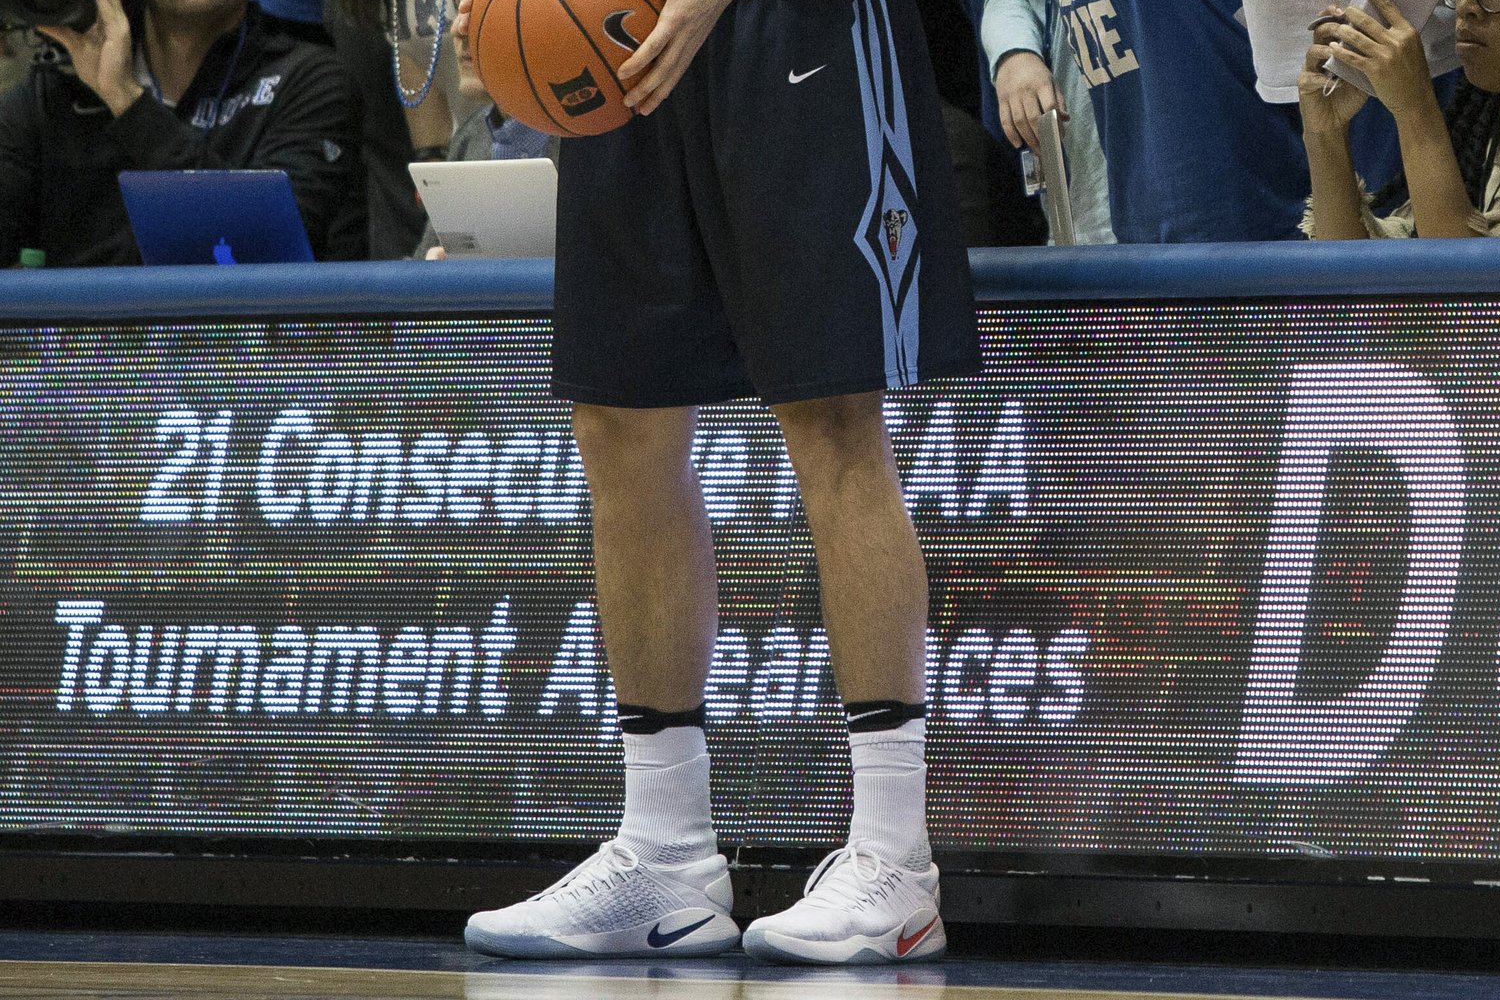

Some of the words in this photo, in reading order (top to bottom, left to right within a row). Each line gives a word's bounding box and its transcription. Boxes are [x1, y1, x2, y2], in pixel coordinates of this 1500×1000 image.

[139, 410, 233, 521] 21
[255, 408, 748, 525] Consecue
[55, 594, 518, 721] Tournament
